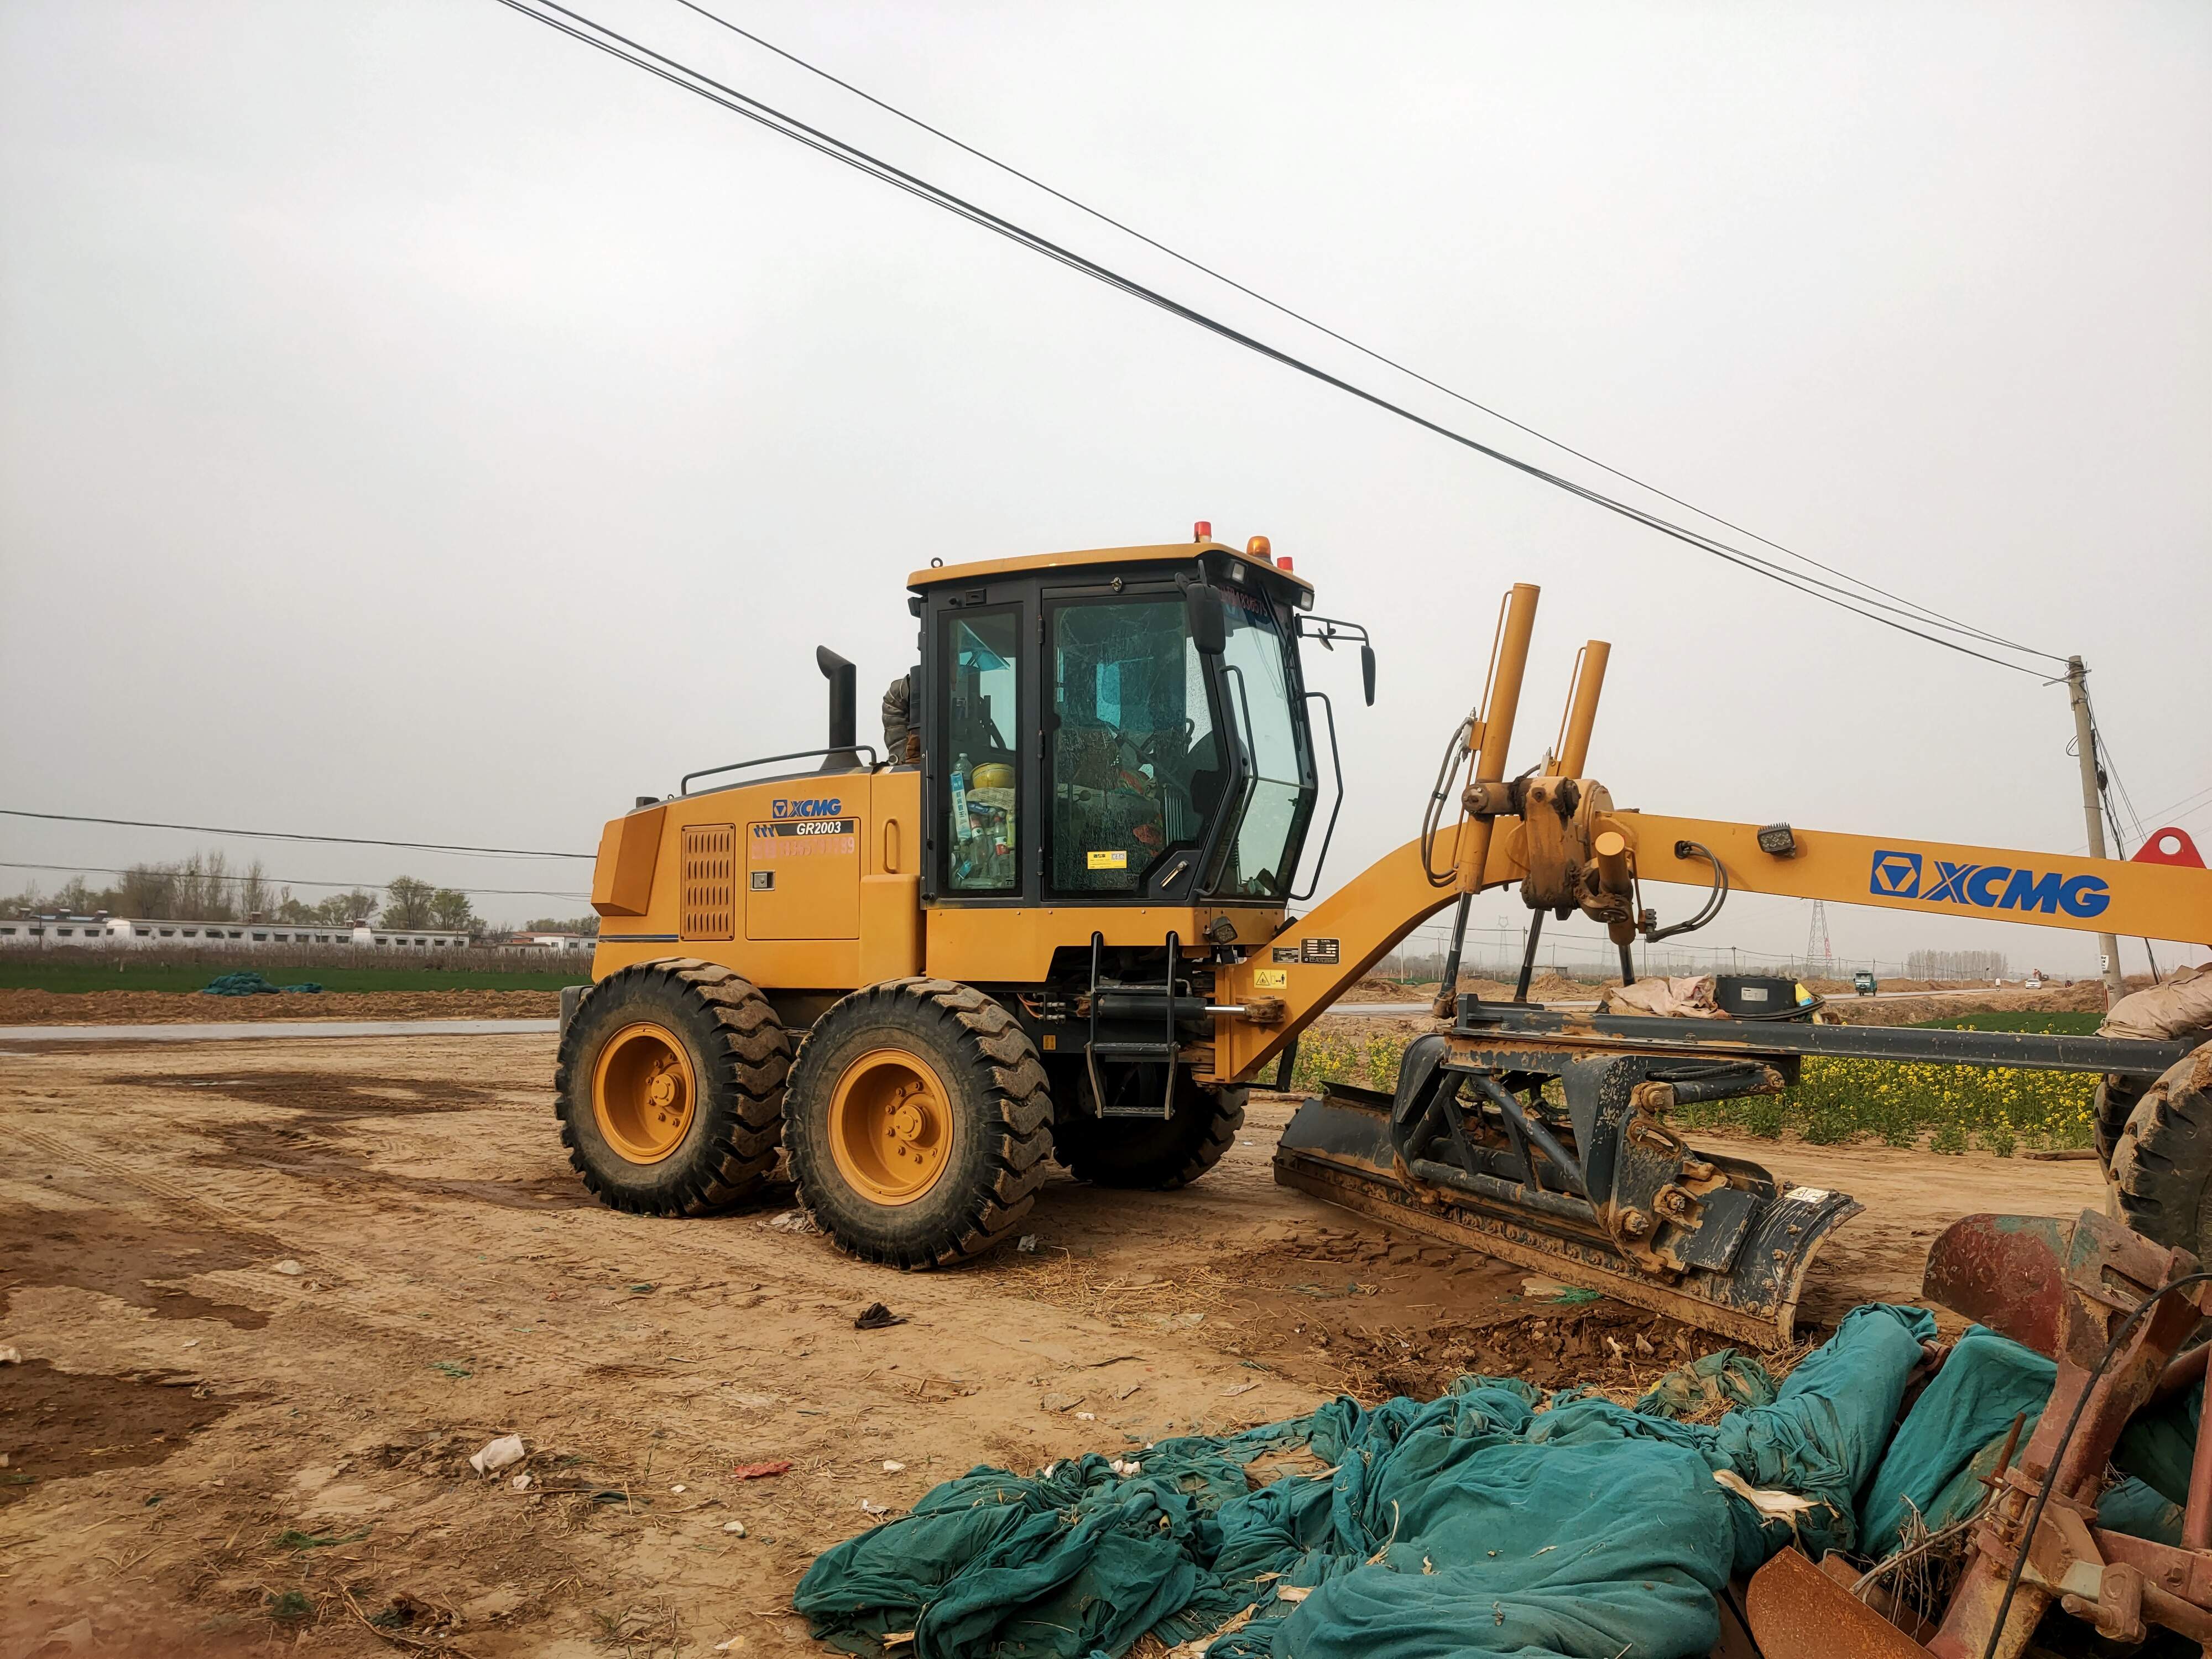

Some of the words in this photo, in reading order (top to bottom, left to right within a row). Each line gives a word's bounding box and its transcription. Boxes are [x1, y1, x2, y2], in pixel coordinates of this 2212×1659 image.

[788, 799, 841, 817] XCMG
[797, 821, 841, 835] GR2003
[1918, 860, 2111, 918] XCMG
